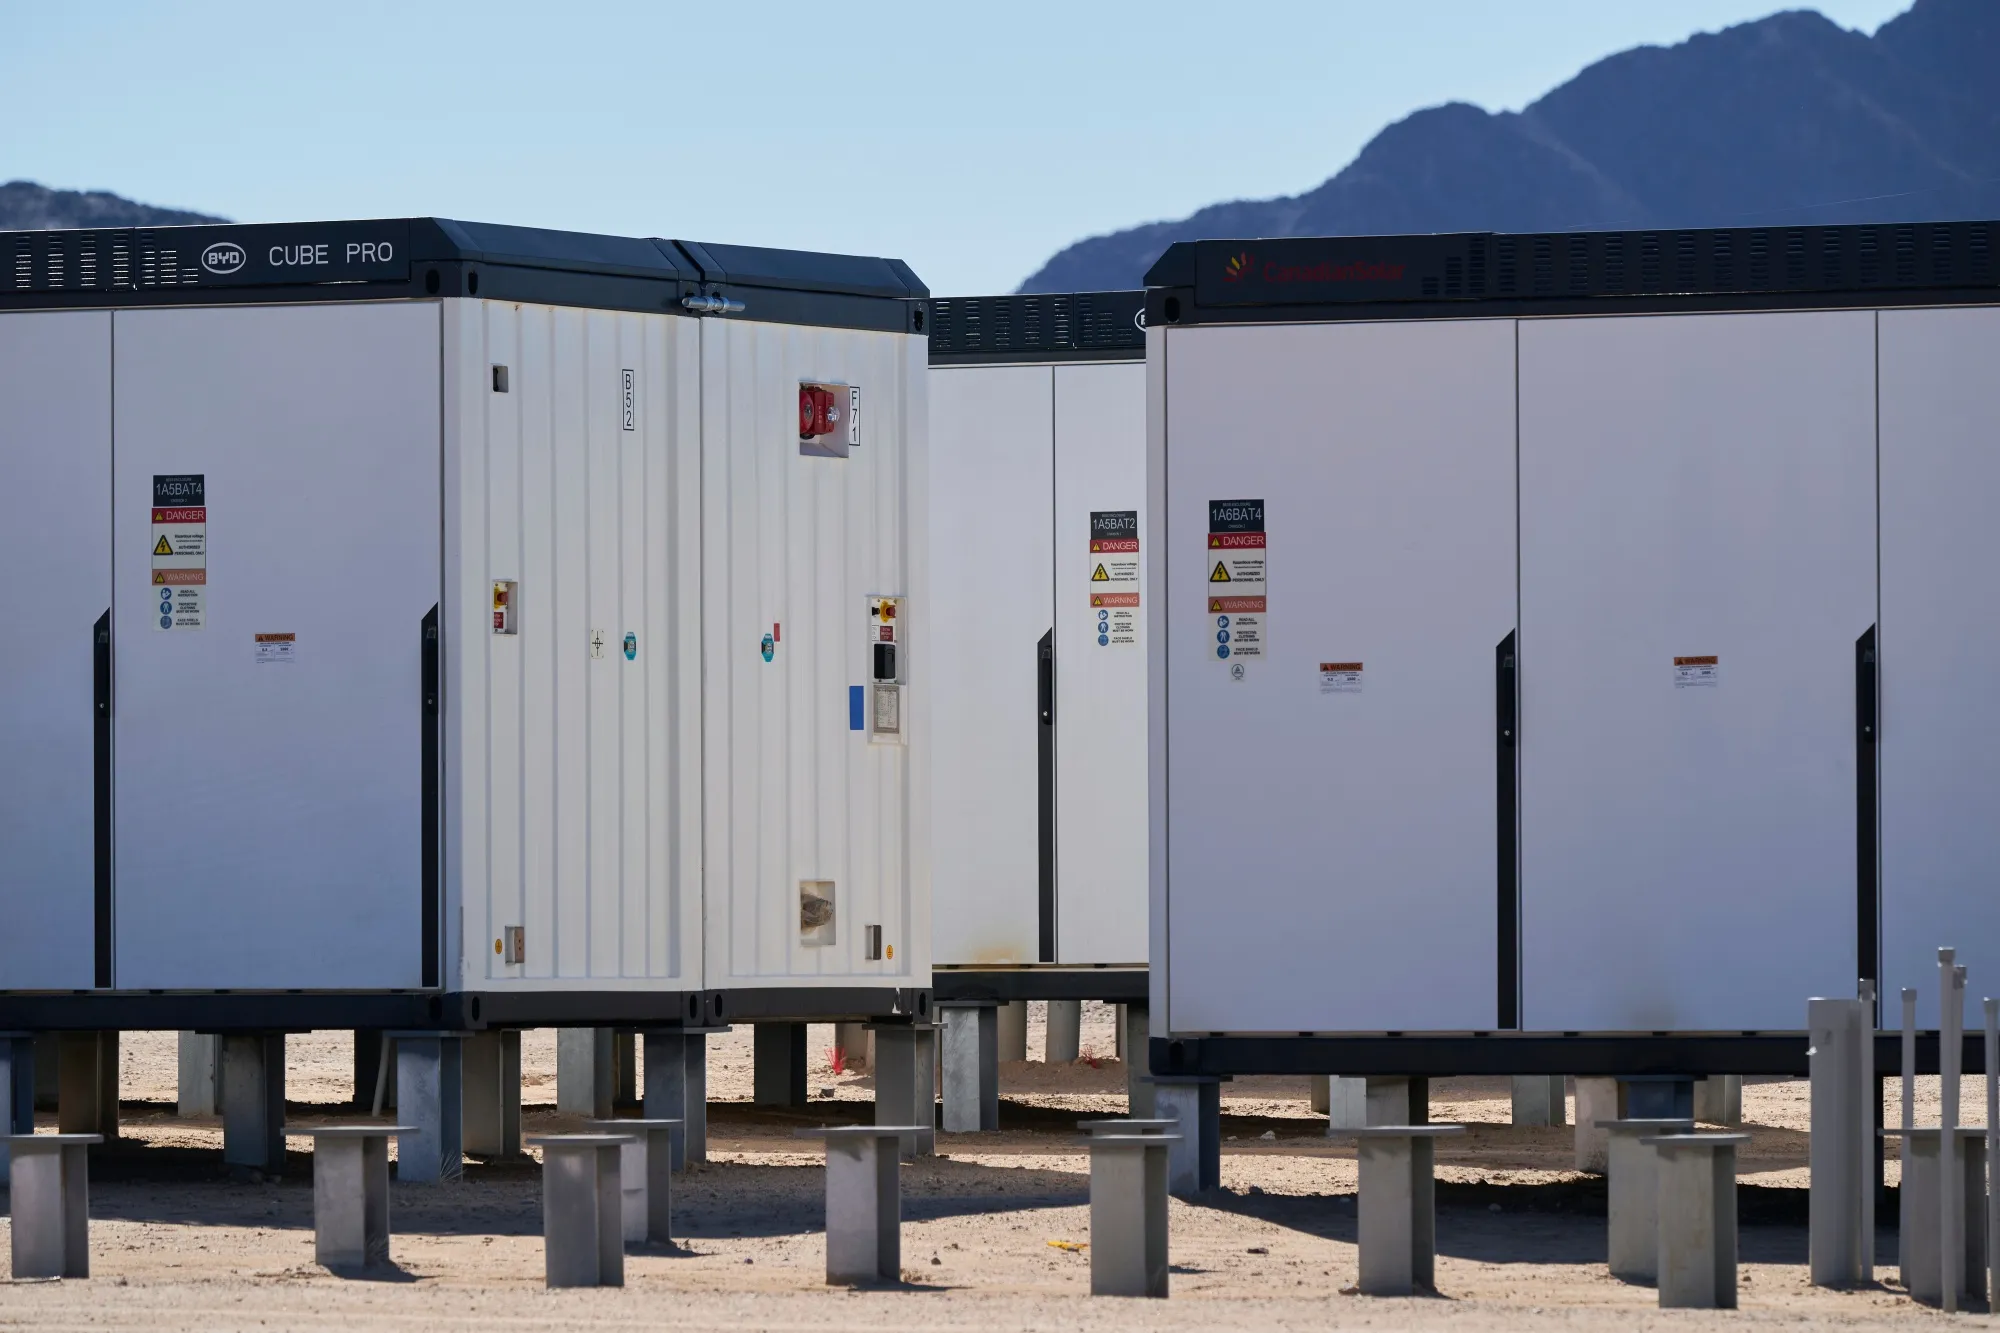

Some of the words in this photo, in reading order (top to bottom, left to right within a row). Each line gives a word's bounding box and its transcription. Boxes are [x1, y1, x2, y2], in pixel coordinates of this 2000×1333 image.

[208, 251, 240, 265] BYD
[269, 244, 329, 266] CUBE
[346, 242, 393, 263] PRO
[1263, 260, 1407, 283] CanadianSolar
[624, 373, 633, 427] B52
[156, 482, 203, 496] 1A5BAT4
[166, 510, 204, 521] DANGER
[1212, 507, 1263, 521] 1A6BAT4
[1093, 517, 1136, 530] 1A5BAT2
[1102, 541, 1138, 551] DANGER
[1223, 535, 1264, 546] DANGER
[166, 573, 204, 581] WARNING
[1103, 596, 1138, 604] WARNING
[1224, 600, 1264, 609] WARNING
[264, 634, 294, 642] WARNING
[1330, 662, 1361, 671] WARNING
